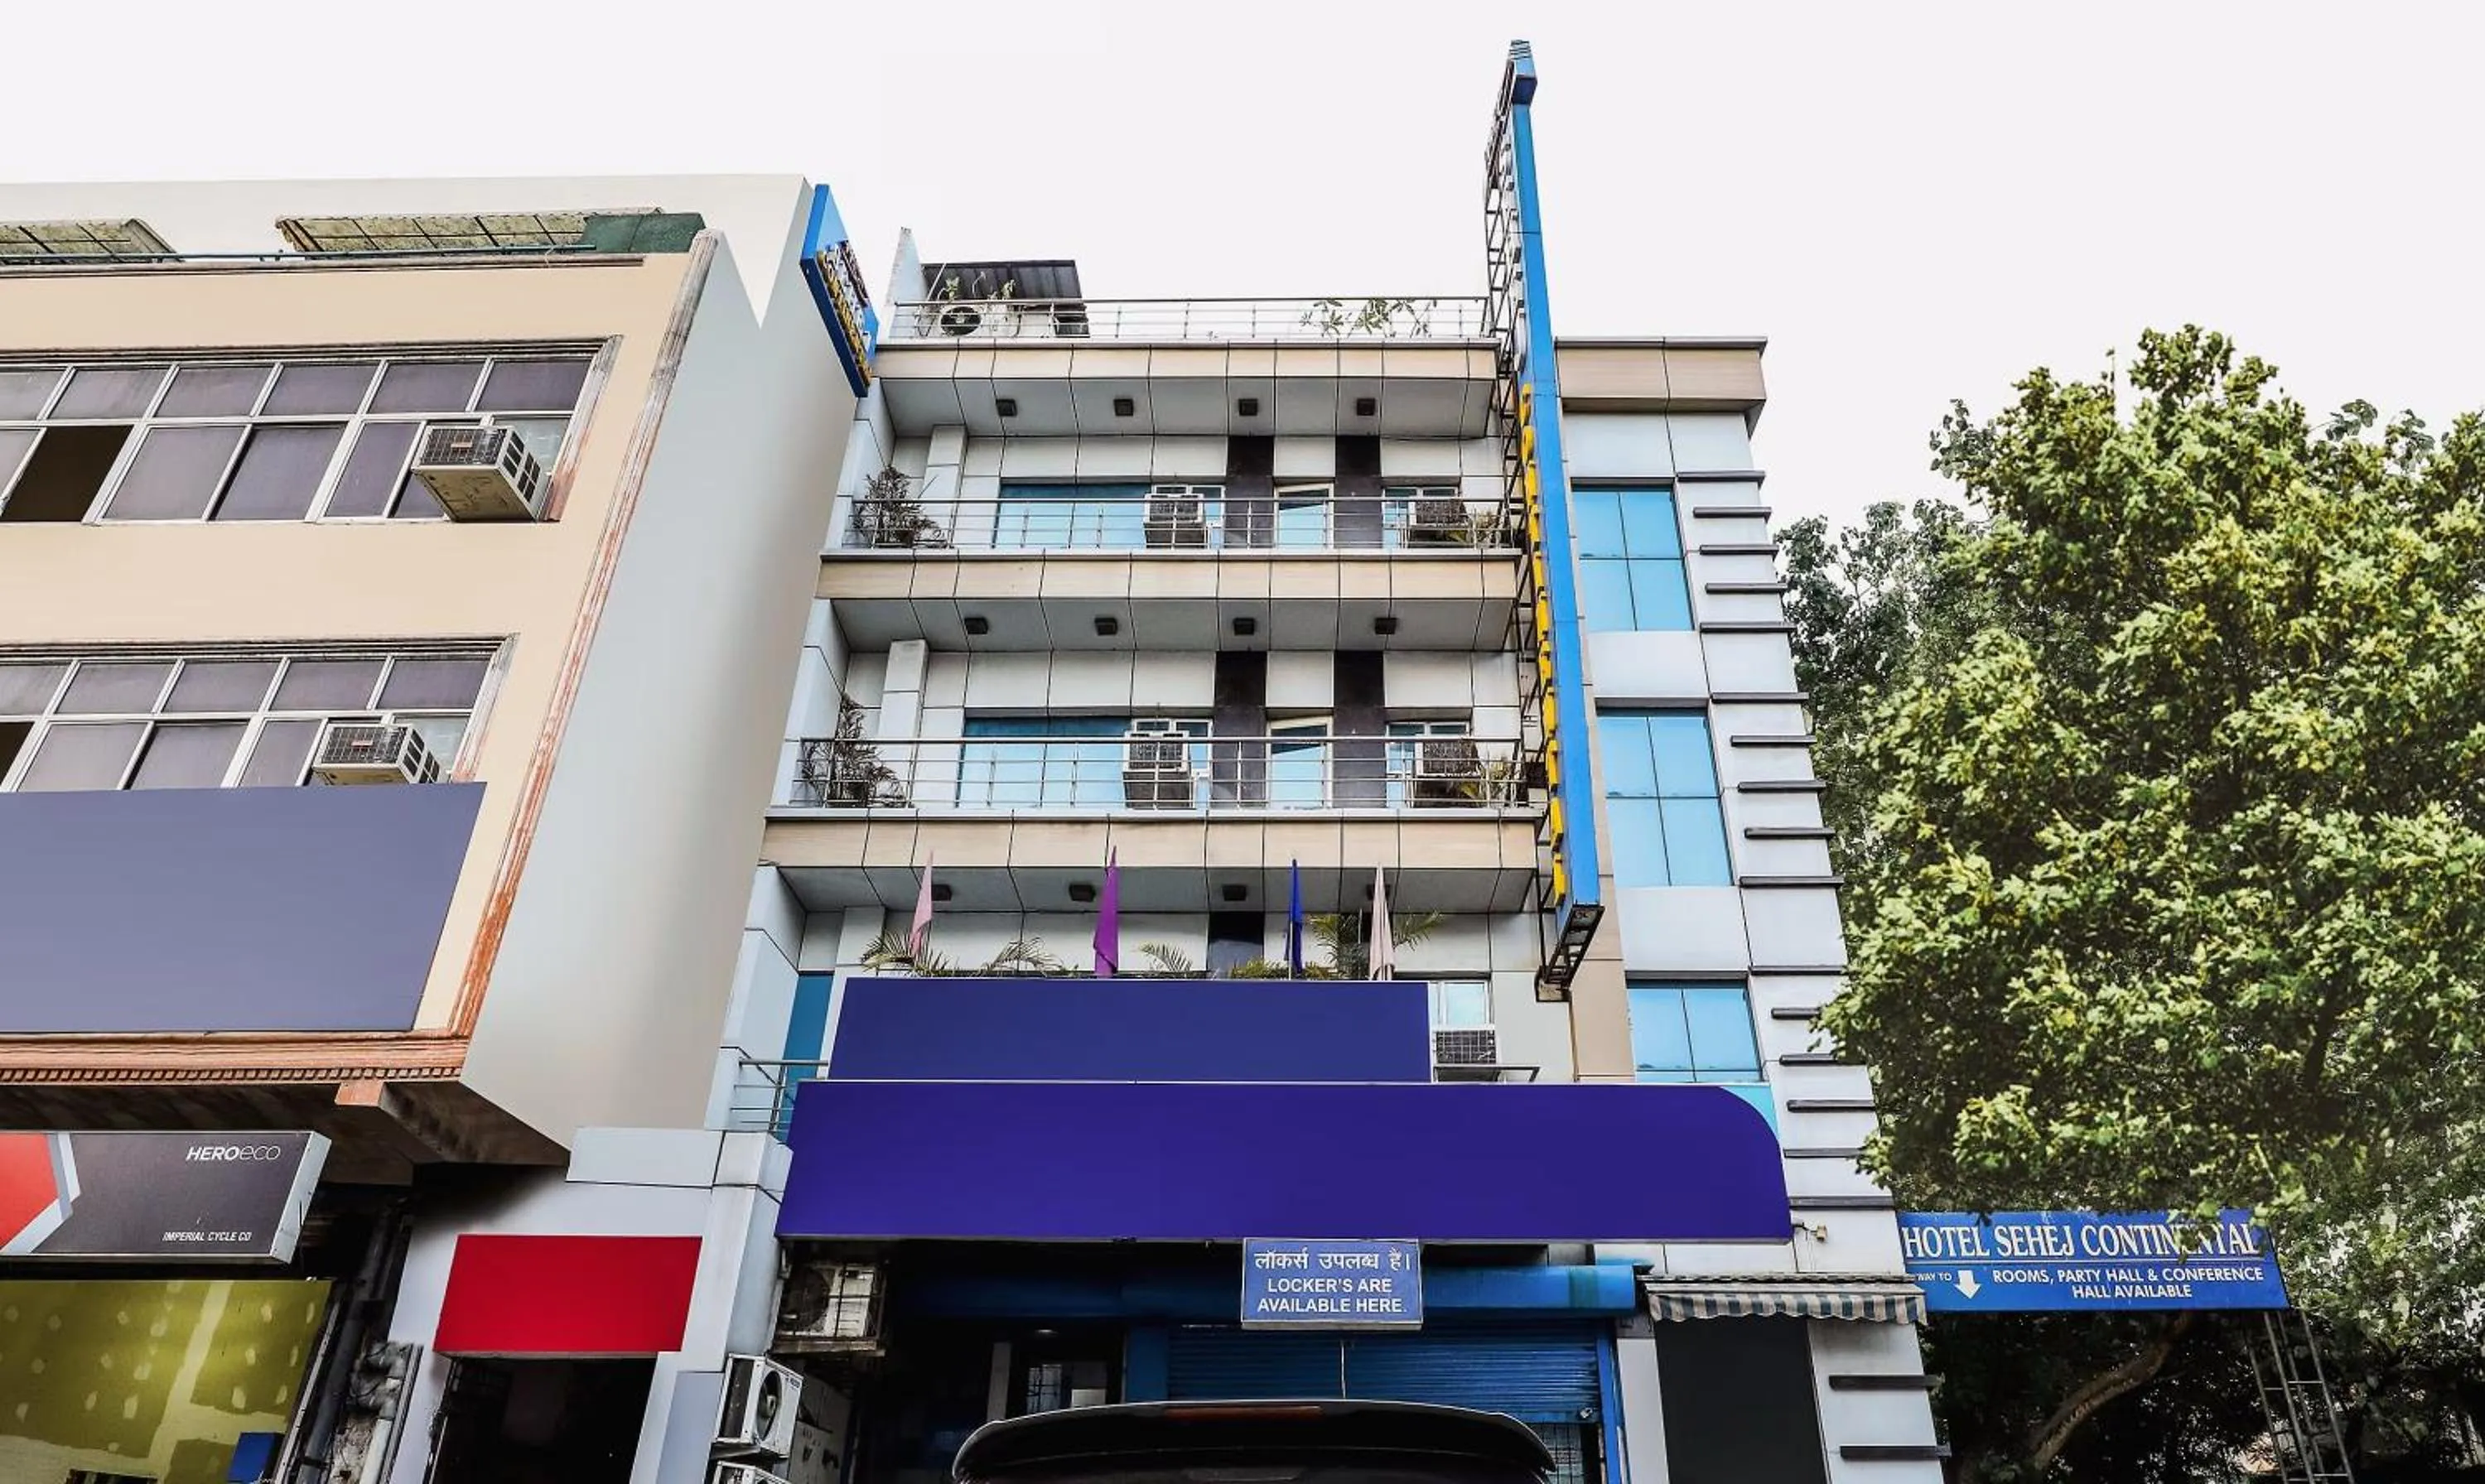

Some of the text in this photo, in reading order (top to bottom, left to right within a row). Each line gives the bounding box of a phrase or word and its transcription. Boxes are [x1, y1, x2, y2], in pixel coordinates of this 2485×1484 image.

[162, 1231, 253, 1241] IMPERIAL CYCLE CO
[1902, 1226, 1990, 1257] HOTEL
[1994, 1225, 2075, 1256] SEHEJ
[1253, 1246, 1310, 1270] लॉकर्स
[1317, 1252, 1379, 1270] उपलब्ध
[1937, 1272, 1952, 1281] TO
[1992, 1267, 2264, 1284] ROOMS, PARTY HALL & CONFERENCE
[1267, 1278, 1392, 1293] LOCKER'S ARE
[2072, 1284, 2193, 1298] HALL AVAILABLE
[1257, 1298, 1407, 1313] AVAILABLE HERE.
